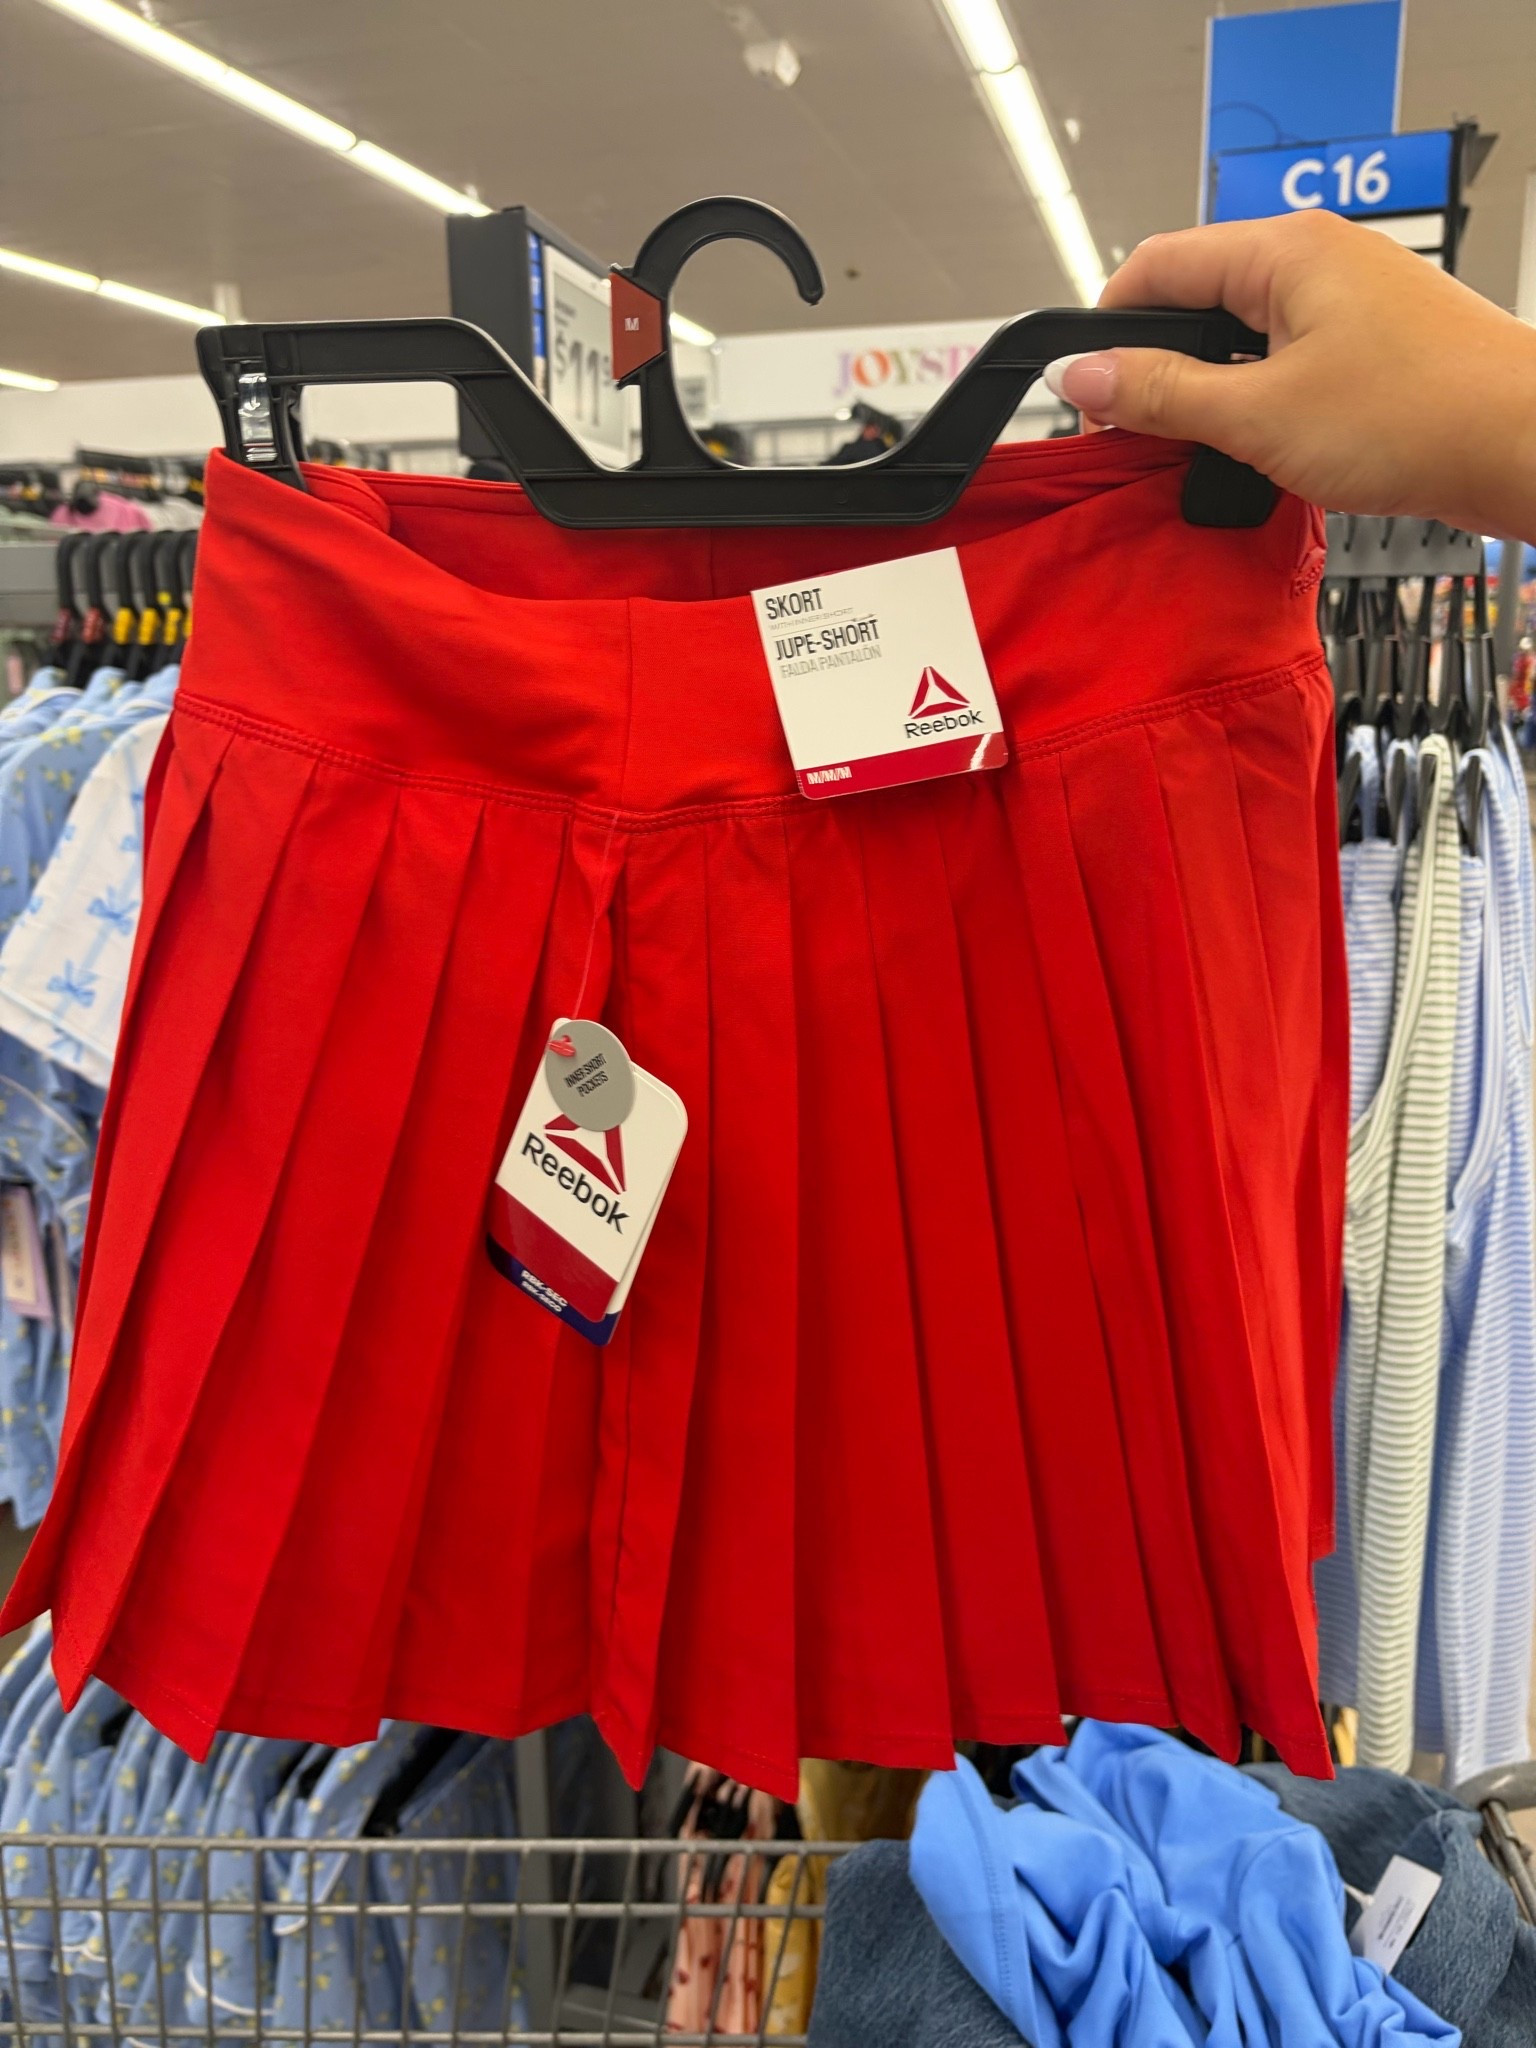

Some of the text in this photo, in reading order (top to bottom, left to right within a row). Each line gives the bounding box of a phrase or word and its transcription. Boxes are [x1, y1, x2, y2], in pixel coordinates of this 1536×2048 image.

[624, 317, 640, 331] M
[765, 588, 823, 620] SKORT
[775, 619, 880, 661] JUPE-SHORT
[780, 659, 819, 679] FALDA
[904, 710, 984, 739] Reebok
[806, 766, 852, 785] M/M/M
[582, 1053, 607, 1075] SHORT
[576, 1071, 609, 1097] POCKETS
[520, 1132, 631, 1234] Reebok
